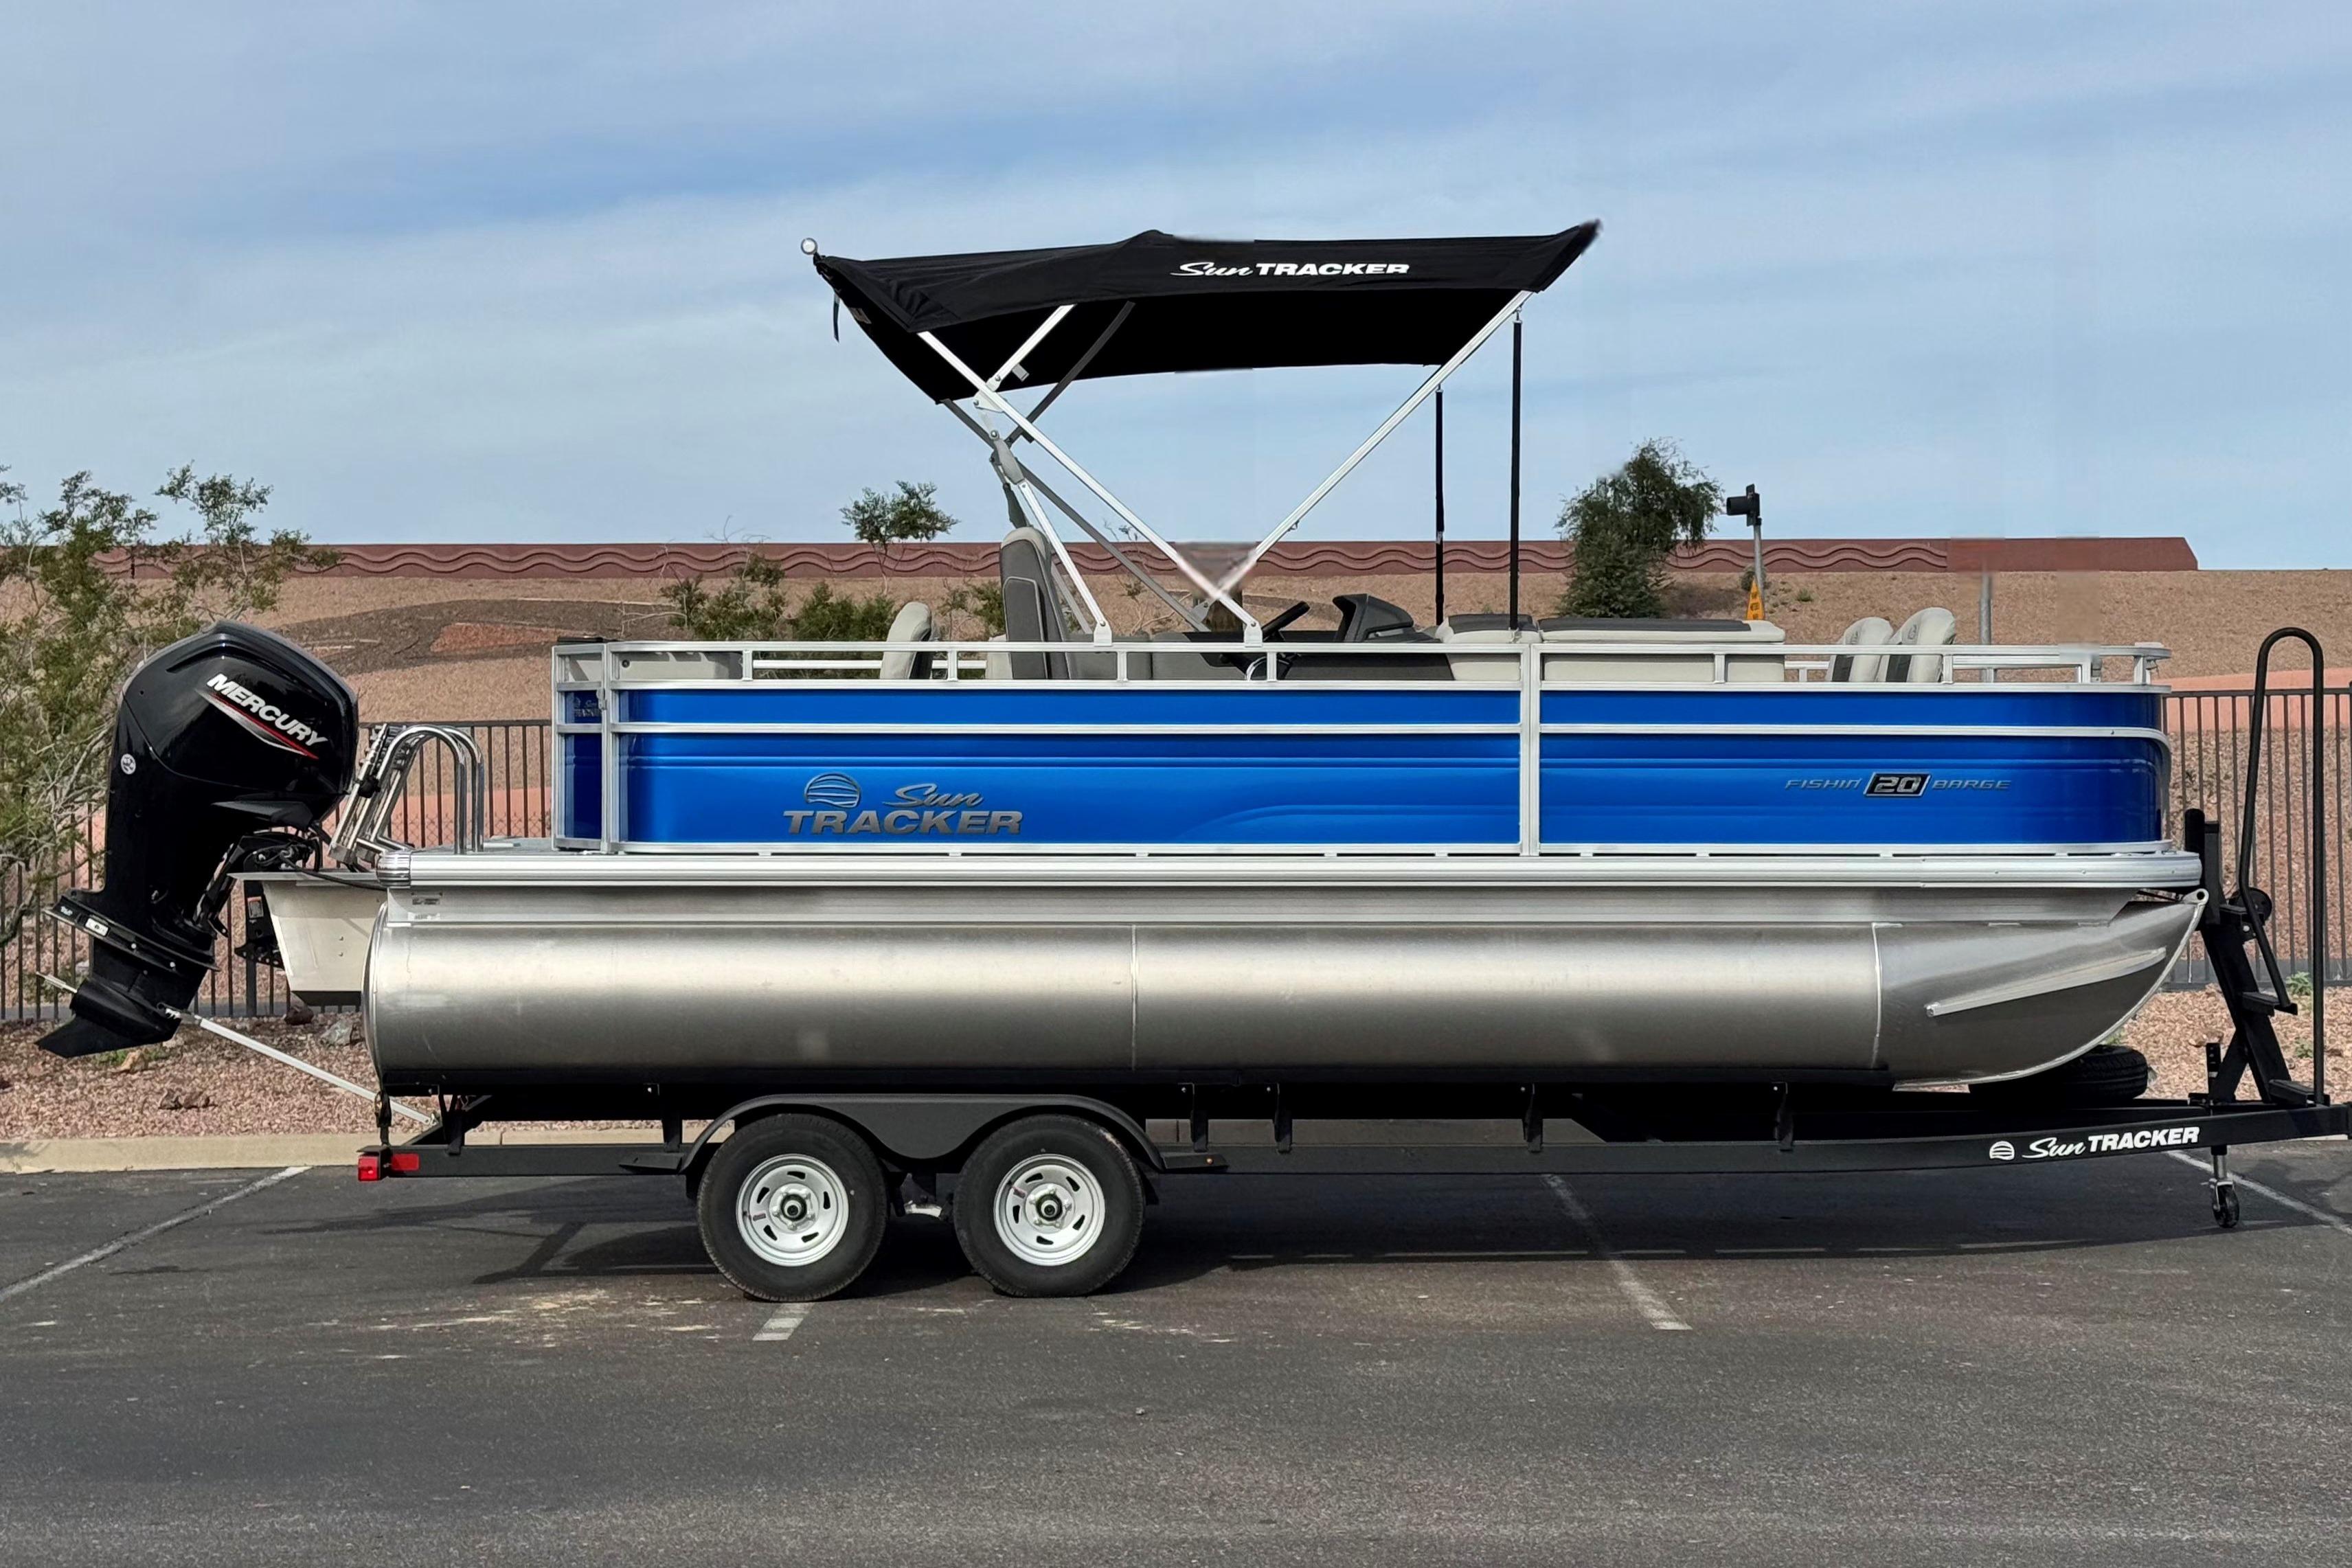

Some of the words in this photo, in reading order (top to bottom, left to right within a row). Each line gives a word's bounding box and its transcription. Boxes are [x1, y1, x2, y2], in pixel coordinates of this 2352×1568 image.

[1170, 262, 1254, 276] Sun
[1256, 263, 1410, 275] TRACKER
[206, 673, 328, 746] MERCURY
[882, 783, 984, 808] Sun
[1873, 777, 1921, 793] 20
[1932, 780, 2011, 790] BARGE
[783, 810, 1023, 835] TRACKER
[2022, 1137, 2085, 1159] Sun
[2088, 1126, 2200, 1152] TRACKER
